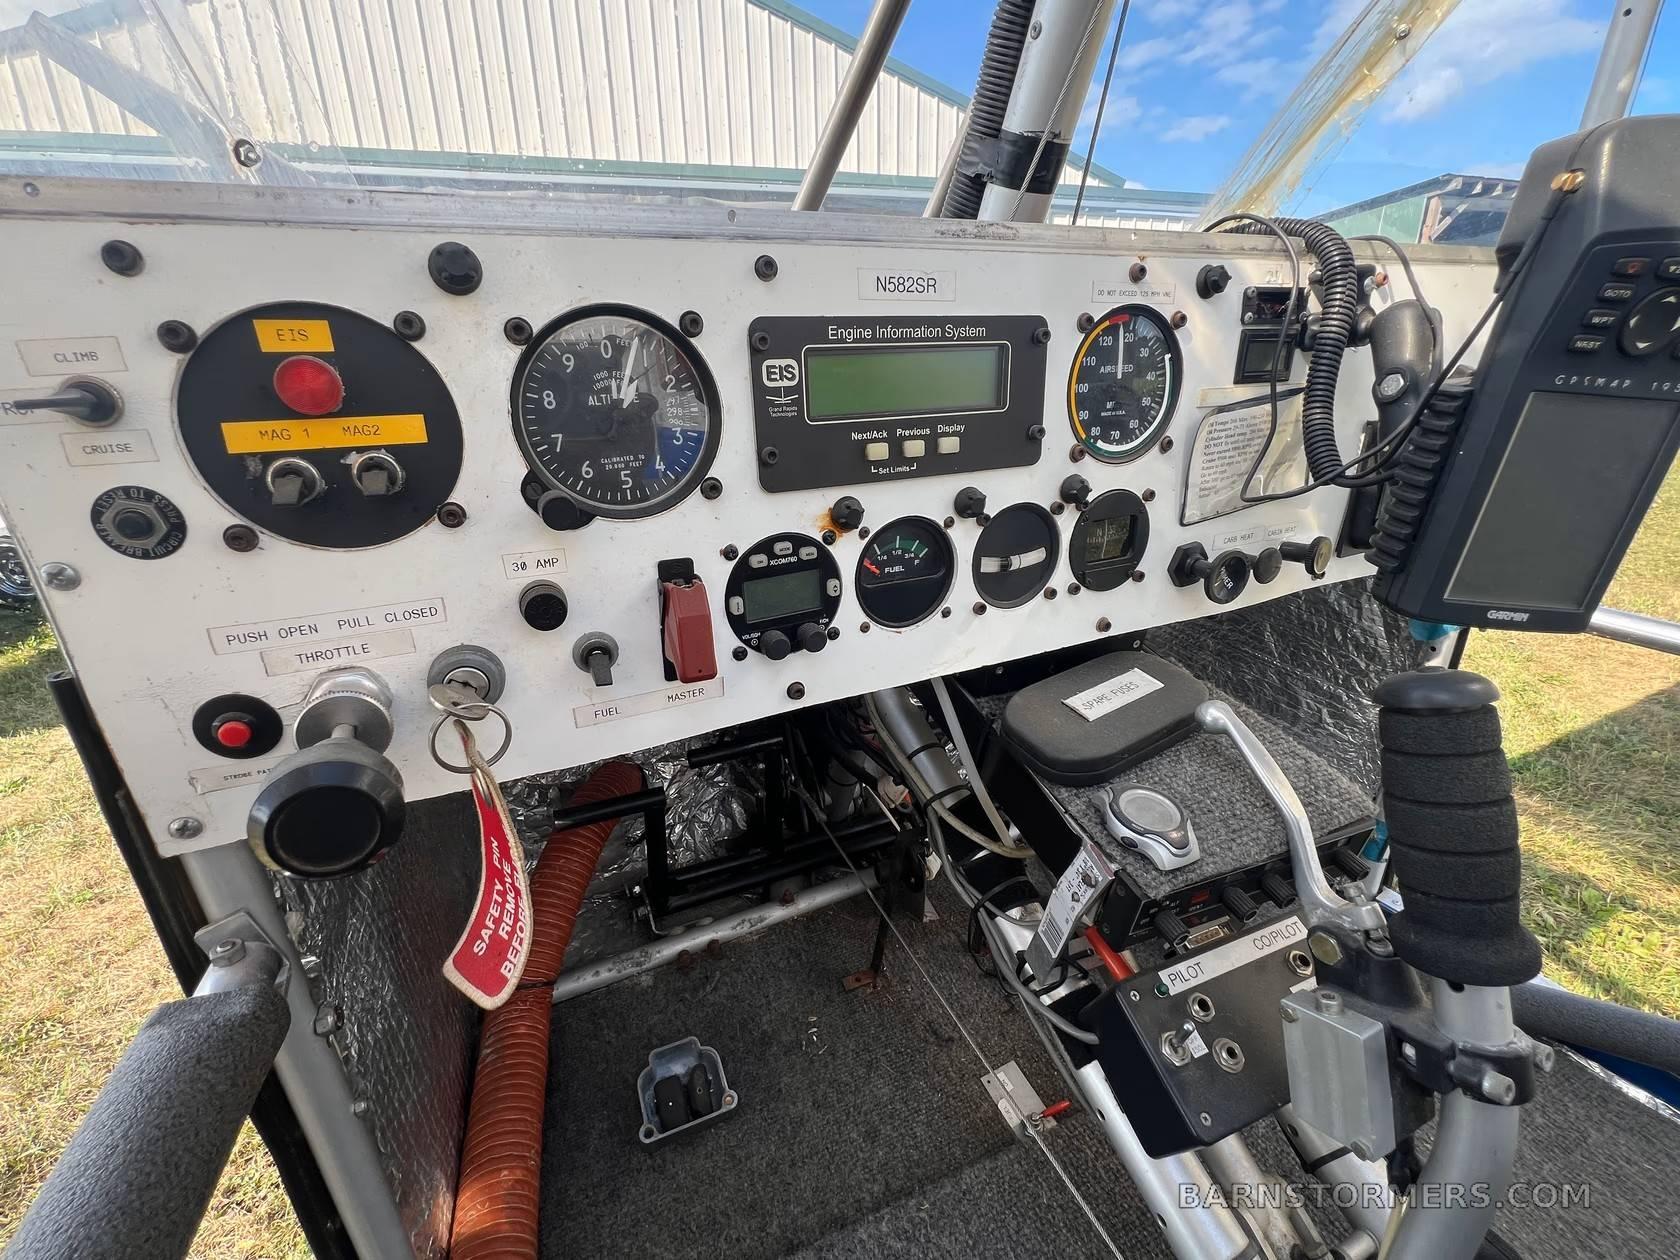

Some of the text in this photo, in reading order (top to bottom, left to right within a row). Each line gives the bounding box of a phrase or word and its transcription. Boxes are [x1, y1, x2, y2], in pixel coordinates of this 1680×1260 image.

[875, 275, 938, 294] N582SR
[1119, 289, 1137, 297] EXCEED
[1604, 289, 1632, 298] GOTO
[1591, 316, 1616, 324] WPT
[276, 328, 310, 342] EIS
[828, 324, 986, 342] Engine Information System
[1099, 335, 1113, 346] 120
[600, 339, 612, 358] 0
[1139, 347, 1149, 358] 30
[53, 351, 99, 364] CLIMB
[562, 353, 575, 373] 9
[1083, 356, 1096, 367] 110
[765, 364, 797, 382] EIS
[1100, 364, 1134, 374] AIRSEED
[1146, 371, 1156, 381] 40
[665, 374, 677, 393] 2
[1075, 383, 1089, 393] 100
[1554, 374, 1632, 388] GPSMAP
[543, 390, 557, 409] 8
[1078, 410, 1089, 420] 90
[342, 424, 381, 437] MAG2
[937, 424, 966, 433] Display
[1090, 426, 1100, 436] 80
[1129, 420, 1139, 429] 60
[258, 427, 310, 442] MAG 1
[671, 427, 683, 445] 3
[851, 429, 888, 441] Next/Ack
[896, 427, 931, 437] Previous
[1110, 430, 1120, 441] 70
[82, 442, 134, 456] CRUISE
[551, 433, 563, 452] 7
[581, 460, 594, 479] 6
[655, 454, 666, 472] 4
[878, 465, 910, 475] Set Limits
[620, 470, 633, 489] 5
[511, 557, 559, 572] 30 AMP
[884, 565, 905, 574] FUEL
[1486, 609, 1530, 622] GARMIN
[225, 606, 438, 646] PUSH OPEN PULL CLOSED
[295, 642, 371, 665] THROTTLE
[666, 687, 705, 703] MASTER
[1082, 681, 1140, 711] SPARE FUSES
[594, 706, 622, 719] FUEL
[473, 836, 504, 957] SAFETY PIN
[498, 858, 513, 941] REMOVE
[1252, 919, 1304, 952] CO/PILOT
[1167, 961, 1206, 986] PILOT
